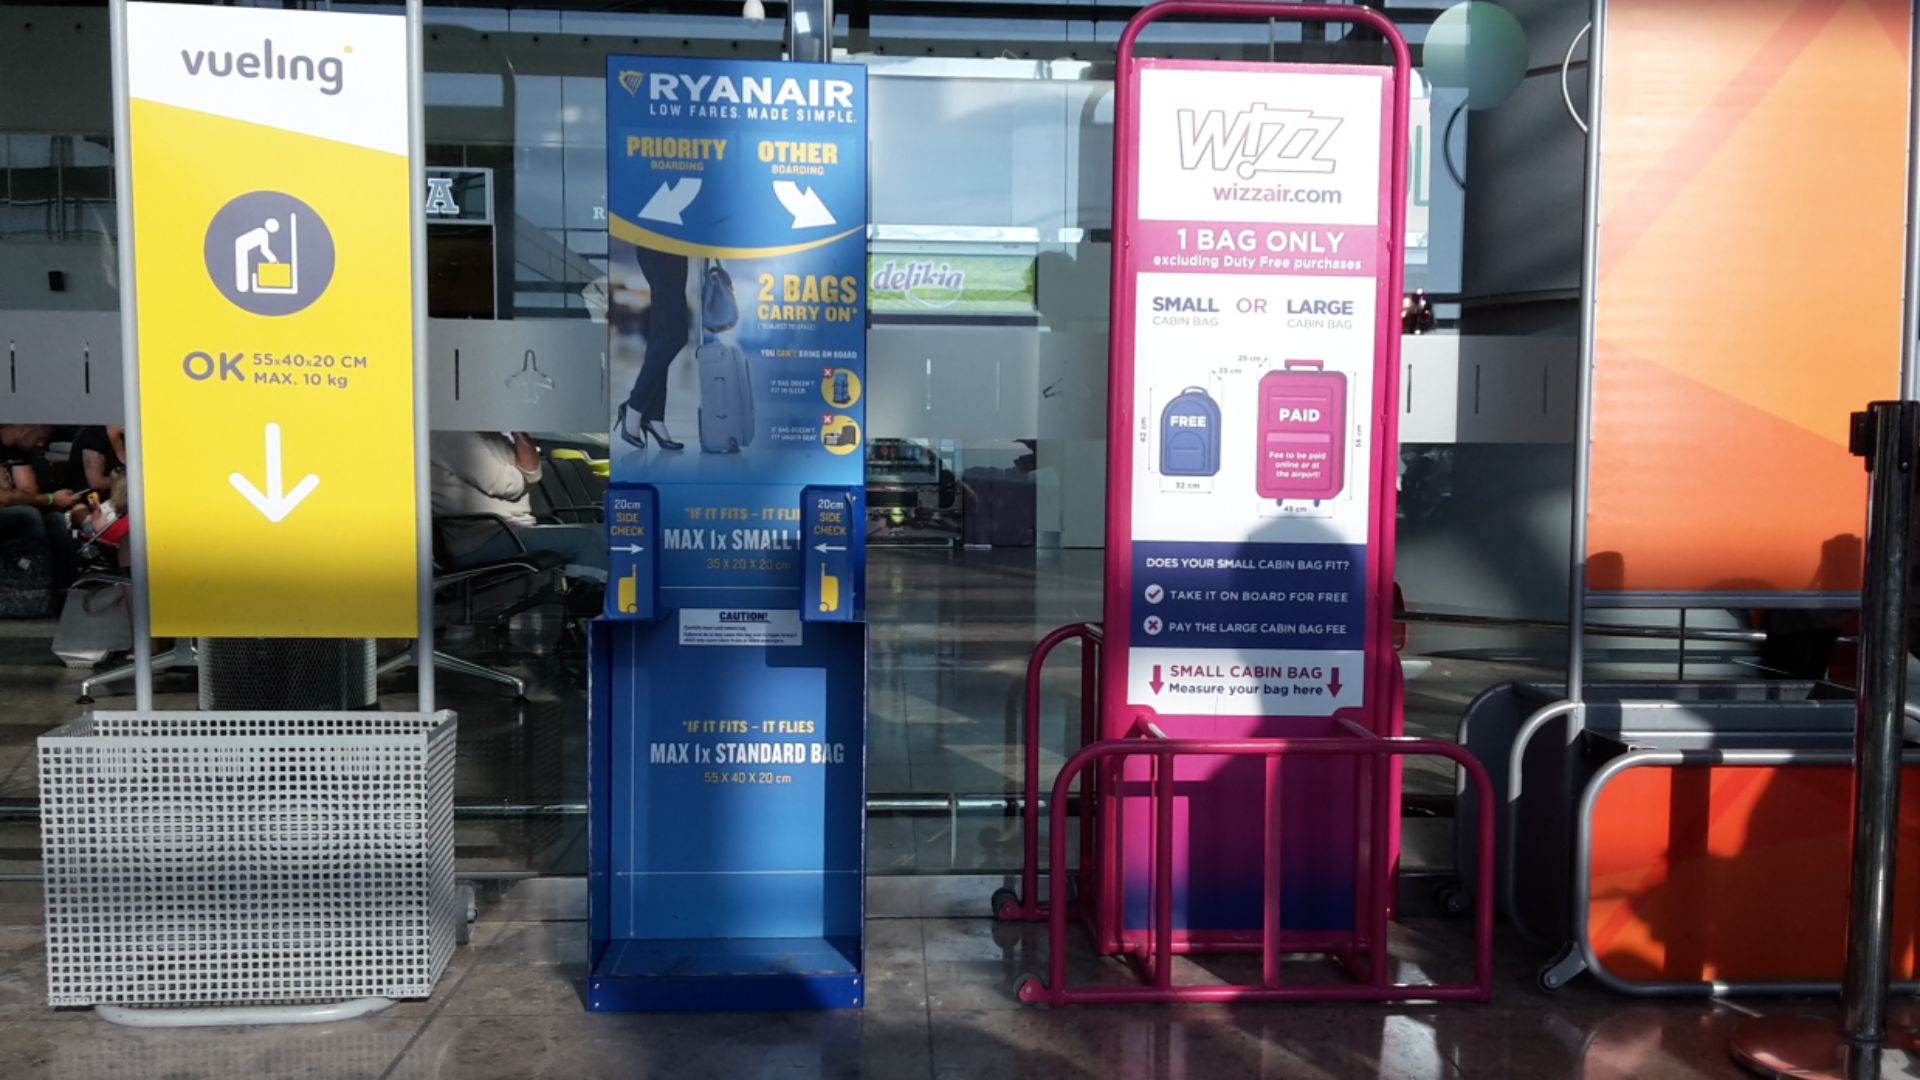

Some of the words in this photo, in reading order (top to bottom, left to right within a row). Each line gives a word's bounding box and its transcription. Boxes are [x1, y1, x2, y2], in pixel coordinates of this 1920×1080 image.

[181, 38, 343, 95] vueling
[649, 73, 853, 108] RYANAIR
[650, 103, 682, 116] LOW
[689, 104, 741, 119] FARES.
[747, 107, 789, 121] MADE
[796, 109, 856, 124] SIMPLE.
[626, 136, 728, 160] PRIORITY
[758, 140, 838, 164] OTHER
[651, 161, 704, 171] BOARDING
[771, 165, 824, 176] BOARDING
[1213, 183, 1342, 204] wizzair.com
[1177, 228, 1187, 249] 1
[1197, 229, 1257, 251] BAG
[1266, 231, 1345, 253] ONLY
[1153, 255, 1219, 269] excluding
[1223, 255, 1256, 269] Duty
[1260, 256, 1290, 269] Free
[1293, 257, 1362, 270] purchases
[873, 262, 963, 290] delikia
[758, 272, 775, 301] 2
[783, 274, 858, 304] BAGS
[757, 304, 820, 321] CARRY
[1152, 296, 1220, 312] SMALL
[1236, 298, 1268, 314] OR
[1286, 300, 1354, 316] LARGE
[1152, 316, 1190, 327] CABIN
[1192, 317, 1219, 327] BAG
[1287, 318, 1324, 329] CABIN
[1327, 319, 1353, 330] BAG
[760, 348, 776, 358] YOU
[822, 350, 832, 359] ON
[833, 350, 858, 359] BOARD
[182, 350, 246, 382] OK
[252, 352, 336, 368] 55x40x20
[341, 355, 368, 369] CM
[254, 371, 298, 386] MAX.
[303, 373, 322, 386] 10
[327, 373, 349, 389] kg
[1170, 415, 1207, 428] FREE
[1279, 408, 1321, 422] PAID
[1269, 451, 1284, 460] Fee
[1286, 451, 1295, 460] to
[1296, 451, 1307, 460] be
[1308, 451, 1327, 462] paid
[1275, 460, 1300, 469] online
[1301, 462, 1310, 470] or
[1311, 462, 1320, 470] at
[1276, 470, 1289, 478] the
[1291, 470, 1321, 480] airport!
[613, 499, 641, 510] 20cm
[817, 499, 844, 510] 20cm
[616, 512, 639, 523] SIDE
[706, 507, 717, 520] IT
[721, 508, 748, 521] FITS
[762, 508, 773, 521] IT
[819, 512, 842, 523] SIDE
[610, 525, 645, 537] CHECK
[814, 525, 847, 537] CHECK
[664, 528, 704, 550] MAX
[731, 530, 792, 551] SMALL
[706, 558, 721, 569] 35
[733, 559, 747, 570] 20
[759, 559, 773, 570] 20
[775, 562, 792, 570] cm
[1146, 558, 1179, 568] DOES
[1181, 558, 1215, 569] YOUR
[1217, 559, 1256, 569] SMALL
[1258, 560, 1295, 570] CABIN
[1298, 560, 1323, 571] BAG
[1325, 561, 1350, 571] FIT?
[1170, 590, 1202, 600] TAKE
[1205, 591, 1216, 600] IT
[1220, 591, 1239, 601] ON
[1242, 591, 1286, 602] BOARD
[1289, 592, 1315, 602] FOR
[1318, 592, 1349, 603] FREE
[719, 611, 768, 621] CAUTION!
[1169, 622, 1192, 632] PAY
[1195, 623, 1217, 633] THE
[1219, 623, 1258, 633] LARGE
[1260, 623, 1296, 634] CABIN
[1298, 624, 1323, 634] BAG
[1326, 624, 1347, 634] FEE
[1170, 665, 1225, 678] SMALL
[1230, 666, 1282, 679] CABIN
[1287, 666, 1323, 679] BAG
[1169, 683, 1225, 694] Measure
[1229, 686, 1259, 696] your
[1263, 684, 1289, 697] bag
[1293, 684, 1323, 695] here
[703, 721, 716, 733] IT
[719, 721, 748, 733] FITS
[762, 721, 775, 733] IT
[778, 721, 815, 733] FLIES
[650, 742, 689, 764] MAX
[715, 743, 806, 764] STANDARD
[810, 743, 844, 764] BAG
[704, 772, 719, 784] 55
[731, 773, 746, 784] 40
[759, 773, 773, 784] 20
[775, 776, 792, 784] cm
